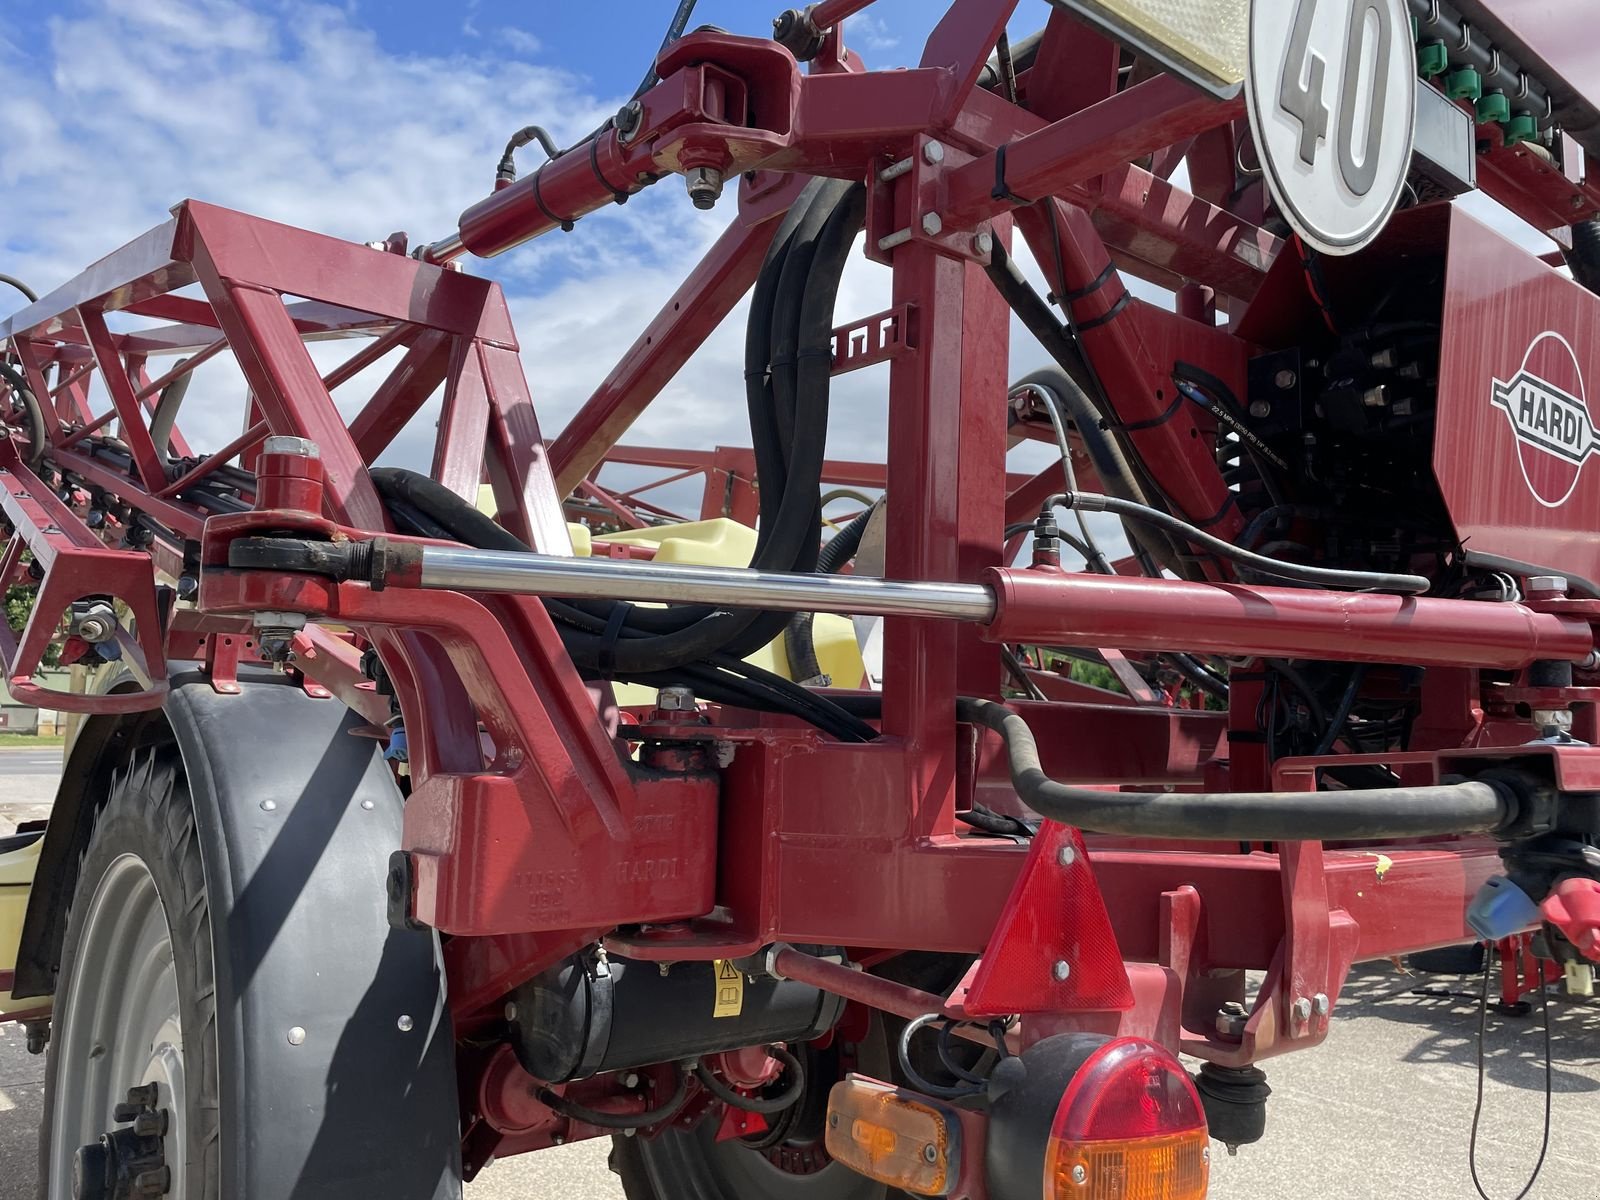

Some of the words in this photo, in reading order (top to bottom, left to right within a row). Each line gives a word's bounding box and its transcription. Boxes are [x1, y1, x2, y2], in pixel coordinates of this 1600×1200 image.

[1281, 0, 1392, 196] 40
[1211, 405, 1224, 417] 22.5
[1222, 413, 1235, 425] MPa
[1519, 386, 1583, 450] HARDI
[617, 858, 678, 883] HARDI
